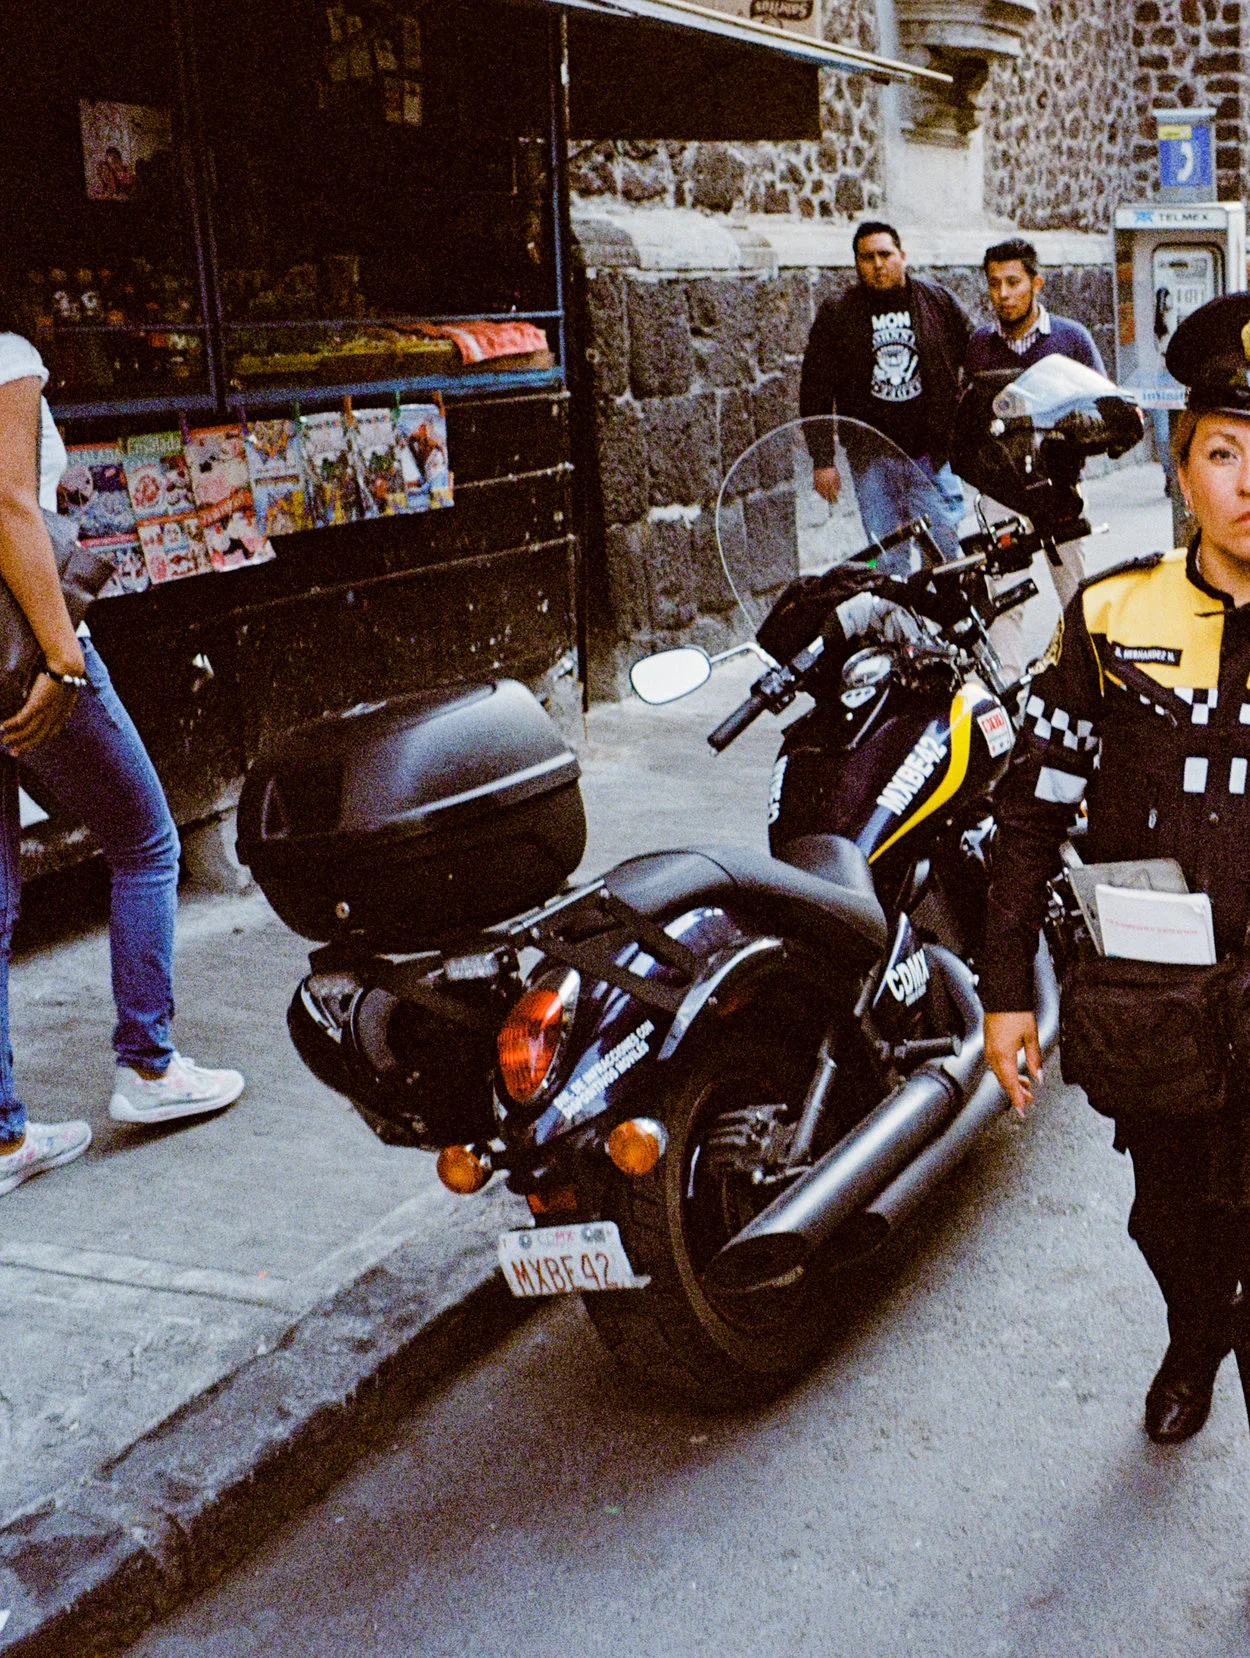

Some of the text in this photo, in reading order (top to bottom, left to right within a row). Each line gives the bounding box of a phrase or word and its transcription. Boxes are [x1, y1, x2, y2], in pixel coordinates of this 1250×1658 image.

[1160, 213, 1208, 221] TELMEX
[872, 311, 911, 331] MON
[876, 736, 948, 816] MXBE42
[885, 948, 930, 1002] CDMX
